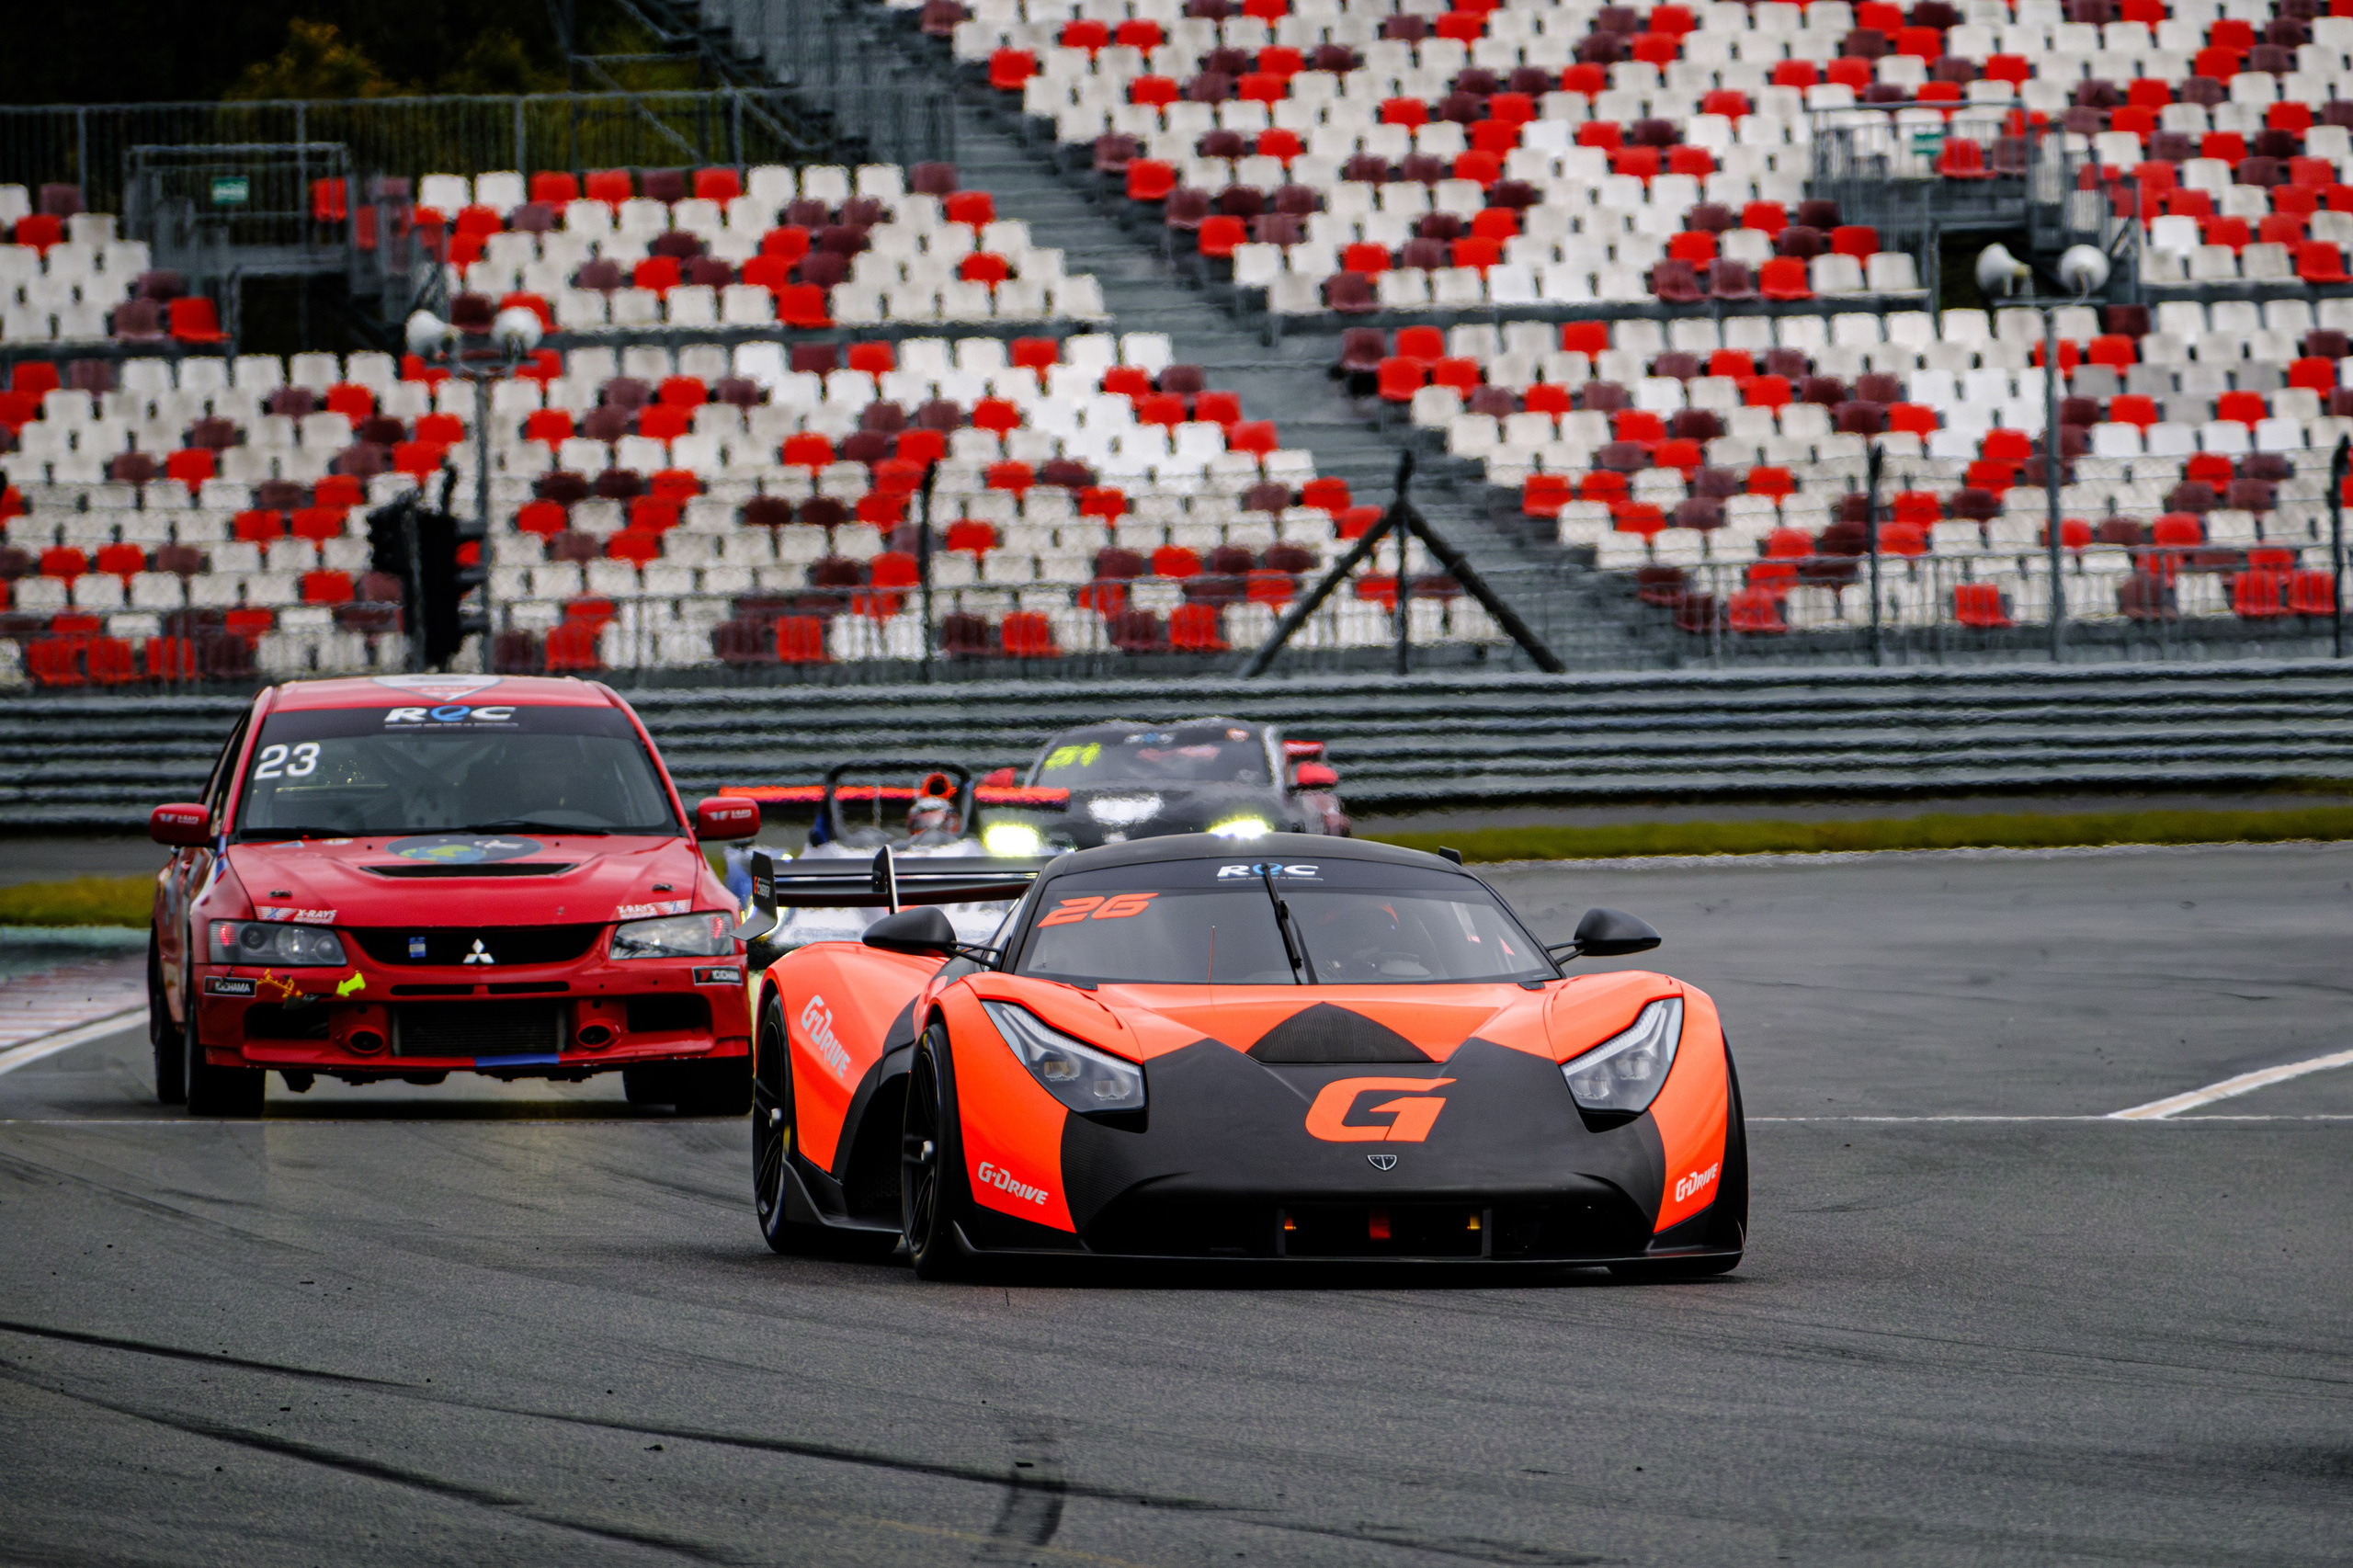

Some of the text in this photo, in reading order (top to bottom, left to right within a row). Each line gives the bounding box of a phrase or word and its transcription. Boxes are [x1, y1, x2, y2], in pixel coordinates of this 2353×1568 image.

[254, 743, 321, 780] 23
[294, 909, 337, 918] X-RAYS
[1037, 892, 1159, 928] 26
[1305, 1076, 1458, 1142] G
